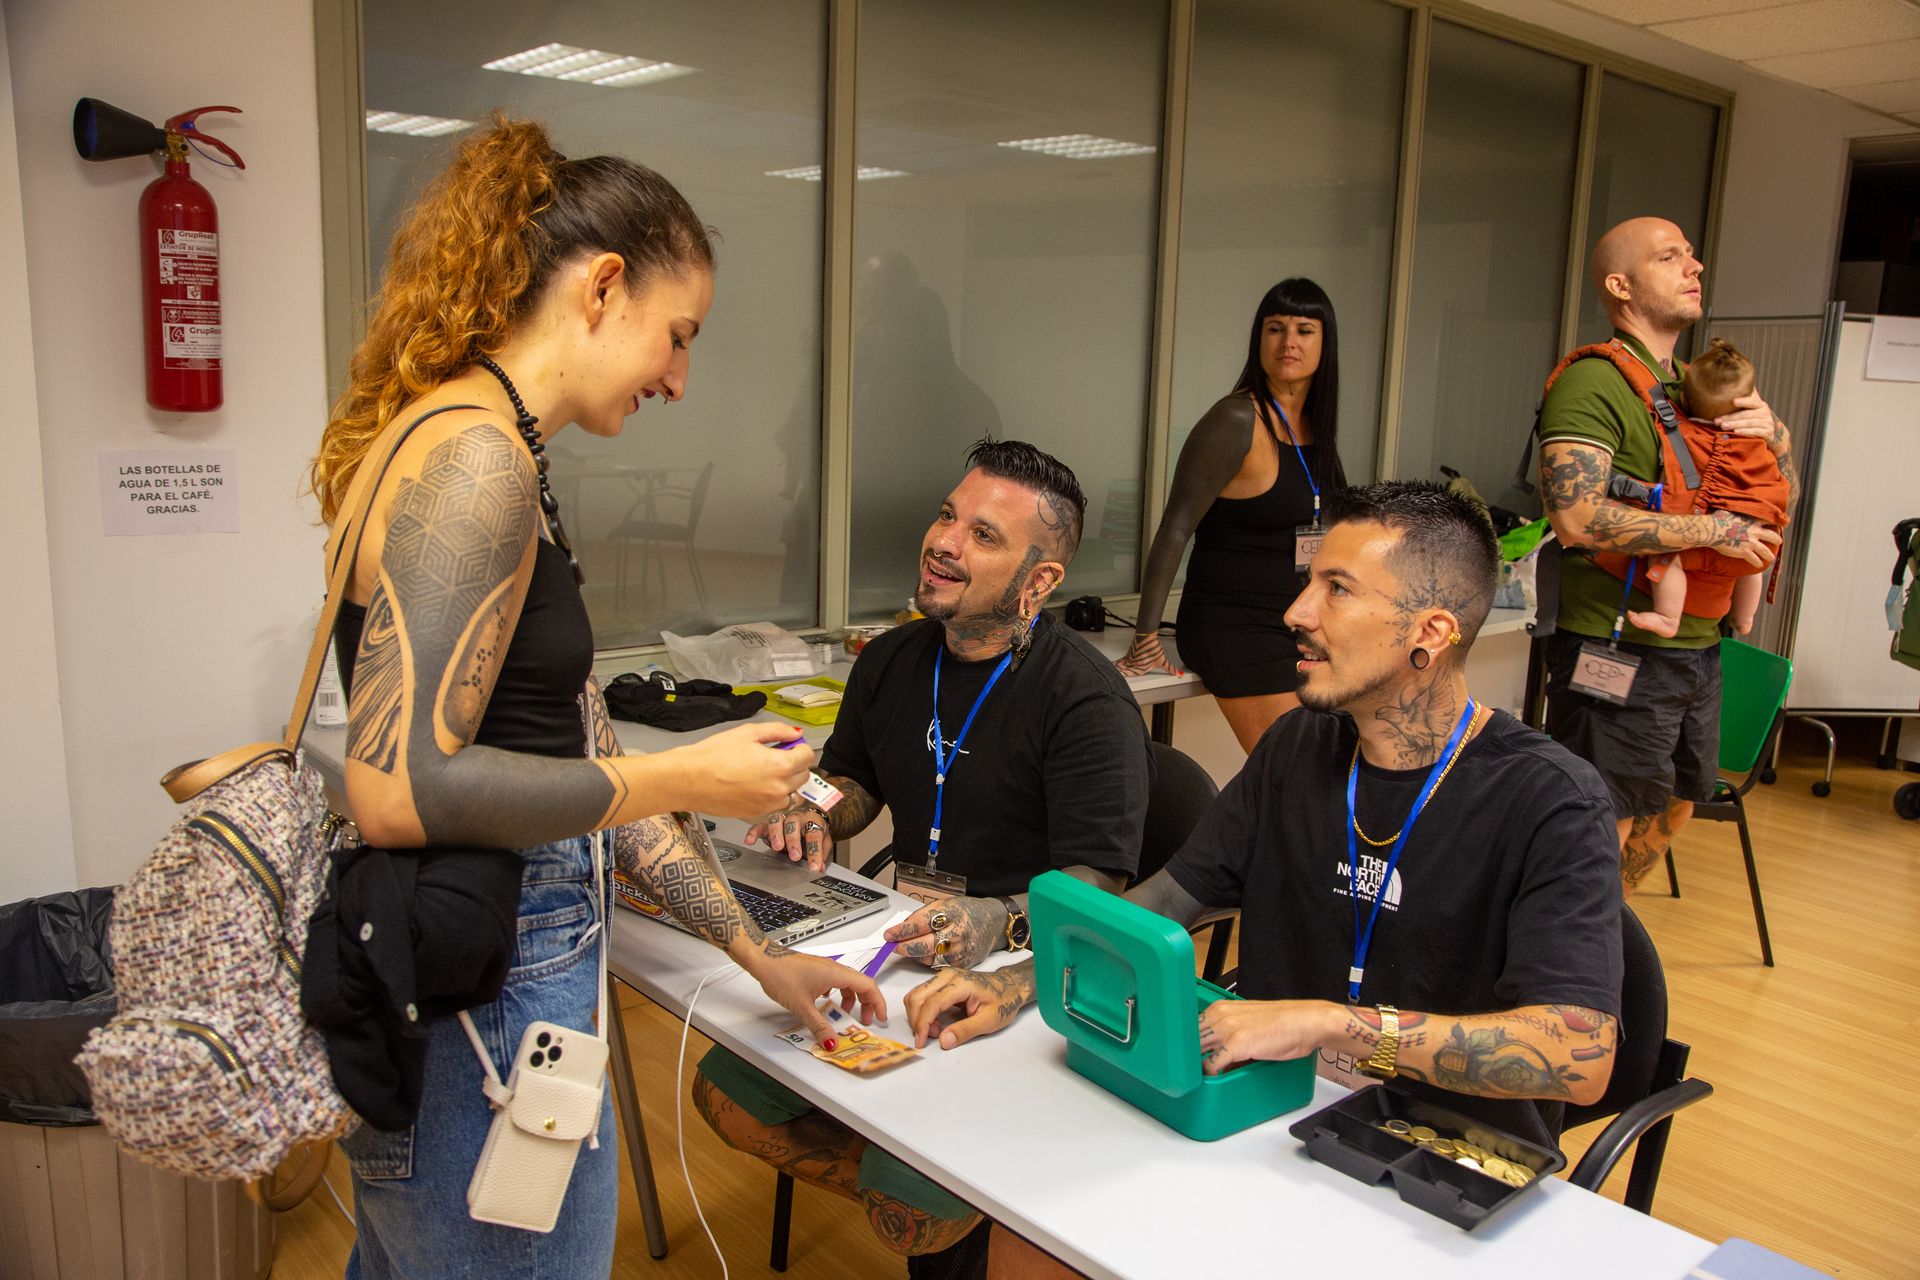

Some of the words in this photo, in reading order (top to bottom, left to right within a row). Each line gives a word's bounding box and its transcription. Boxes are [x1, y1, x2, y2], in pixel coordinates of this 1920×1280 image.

[119, 466, 142, 475] LAS
[144, 464, 204, 475] BOTELLAS
[206, 464, 221, 473] DE
[118, 479, 152, 489] AGUA
[154, 479, 170, 488] DE
[173, 478, 188, 488] 1,5
[190, 478, 198, 487] L
[200, 477, 223, 487] SON
[130, 492, 162, 502] PARA
[165, 491, 179, 501] EL
[146, 504, 200, 514] GRACIAS.
[1360, 855, 1382, 872] THE
[1349, 891, 1372, 902] APINE
[784, 1032, 805, 1043] 50
